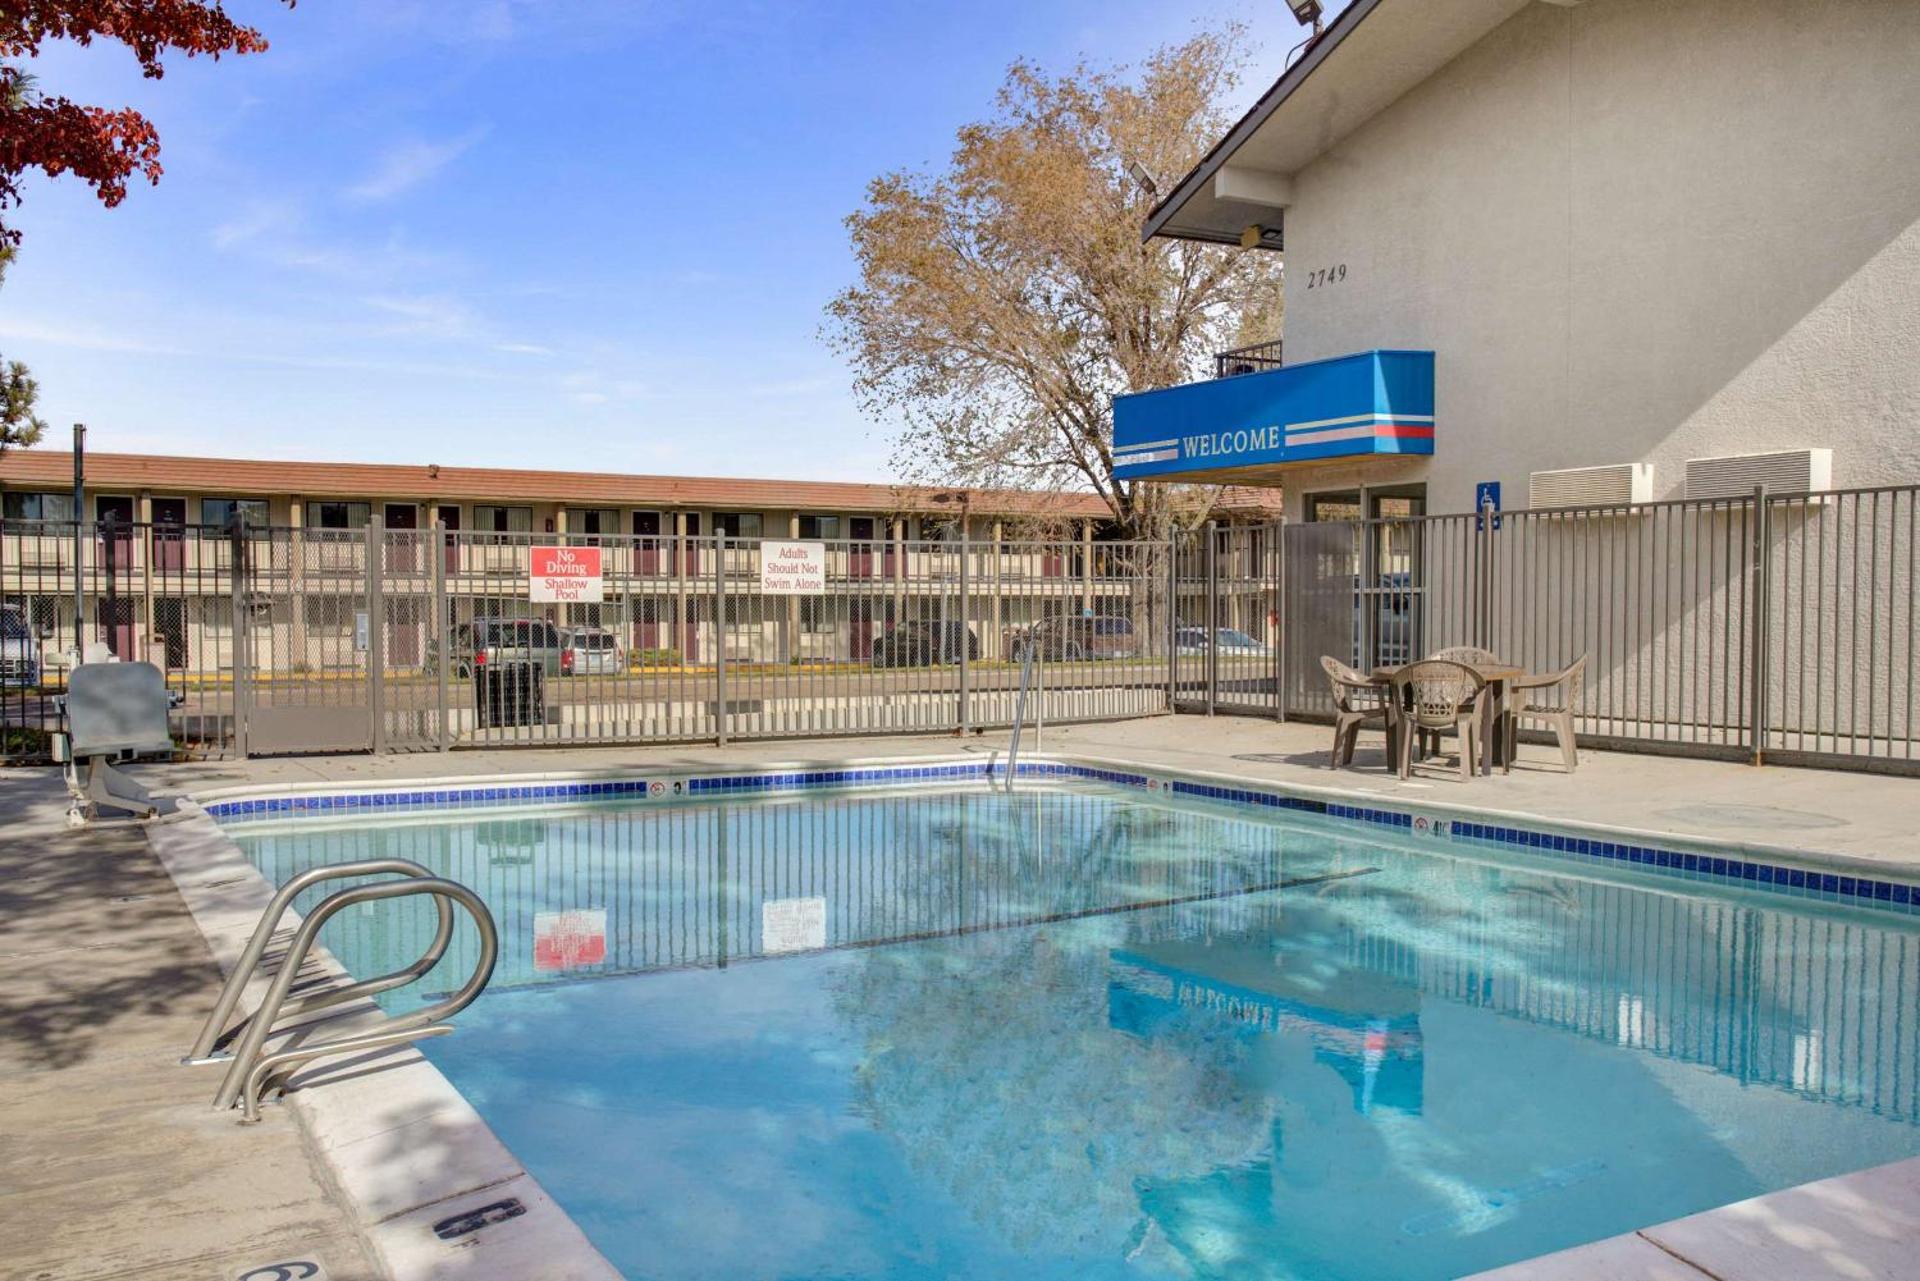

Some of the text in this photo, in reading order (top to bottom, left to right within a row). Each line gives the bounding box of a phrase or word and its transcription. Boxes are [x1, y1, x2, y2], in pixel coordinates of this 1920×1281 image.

[1308, 264, 1346, 289] 2749
[1182, 425, 1280, 459] WELCOME
[557, 550, 576, 562] No
[779, 547, 808, 559] Adults
[546, 561, 588, 577] Diving
[767, 563, 818, 574] Should Not
[544, 579, 588, 590] Shallow
[765, 577, 821, 589] Swim Alone
[556, 589, 579, 600] Pool
